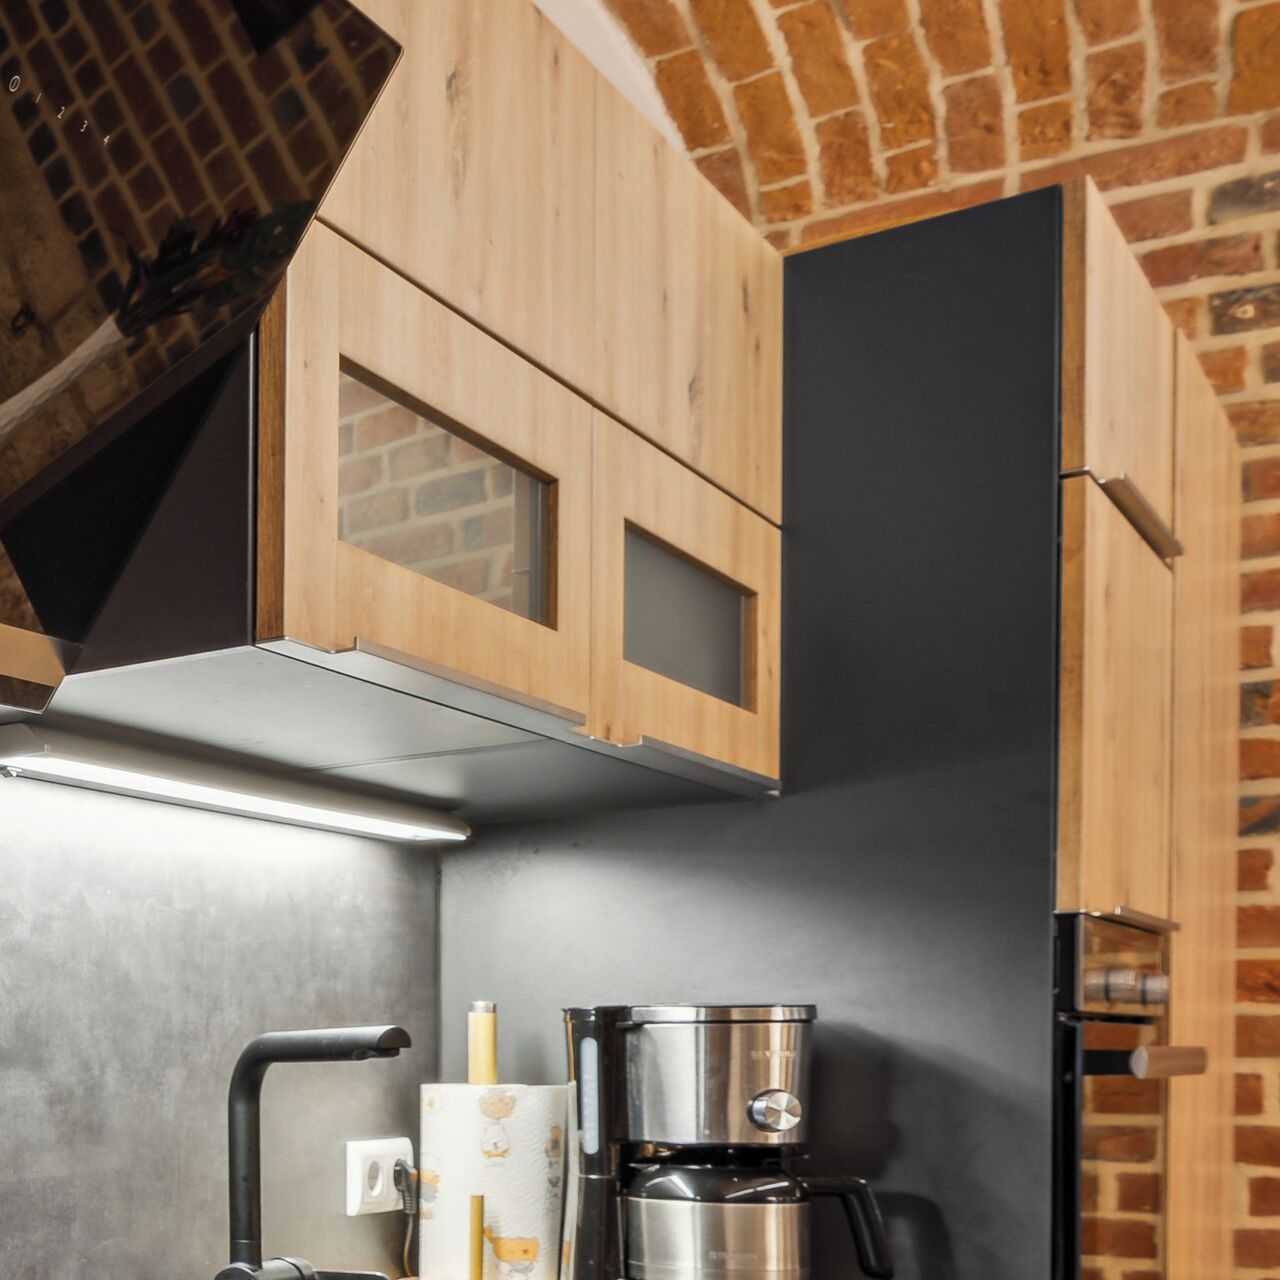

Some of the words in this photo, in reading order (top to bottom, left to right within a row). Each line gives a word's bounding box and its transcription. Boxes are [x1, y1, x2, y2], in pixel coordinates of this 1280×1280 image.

[57, 106, 65, 119] 2
[80, 120, 88, 132] 3
[103, 135, 111, 147] 4
